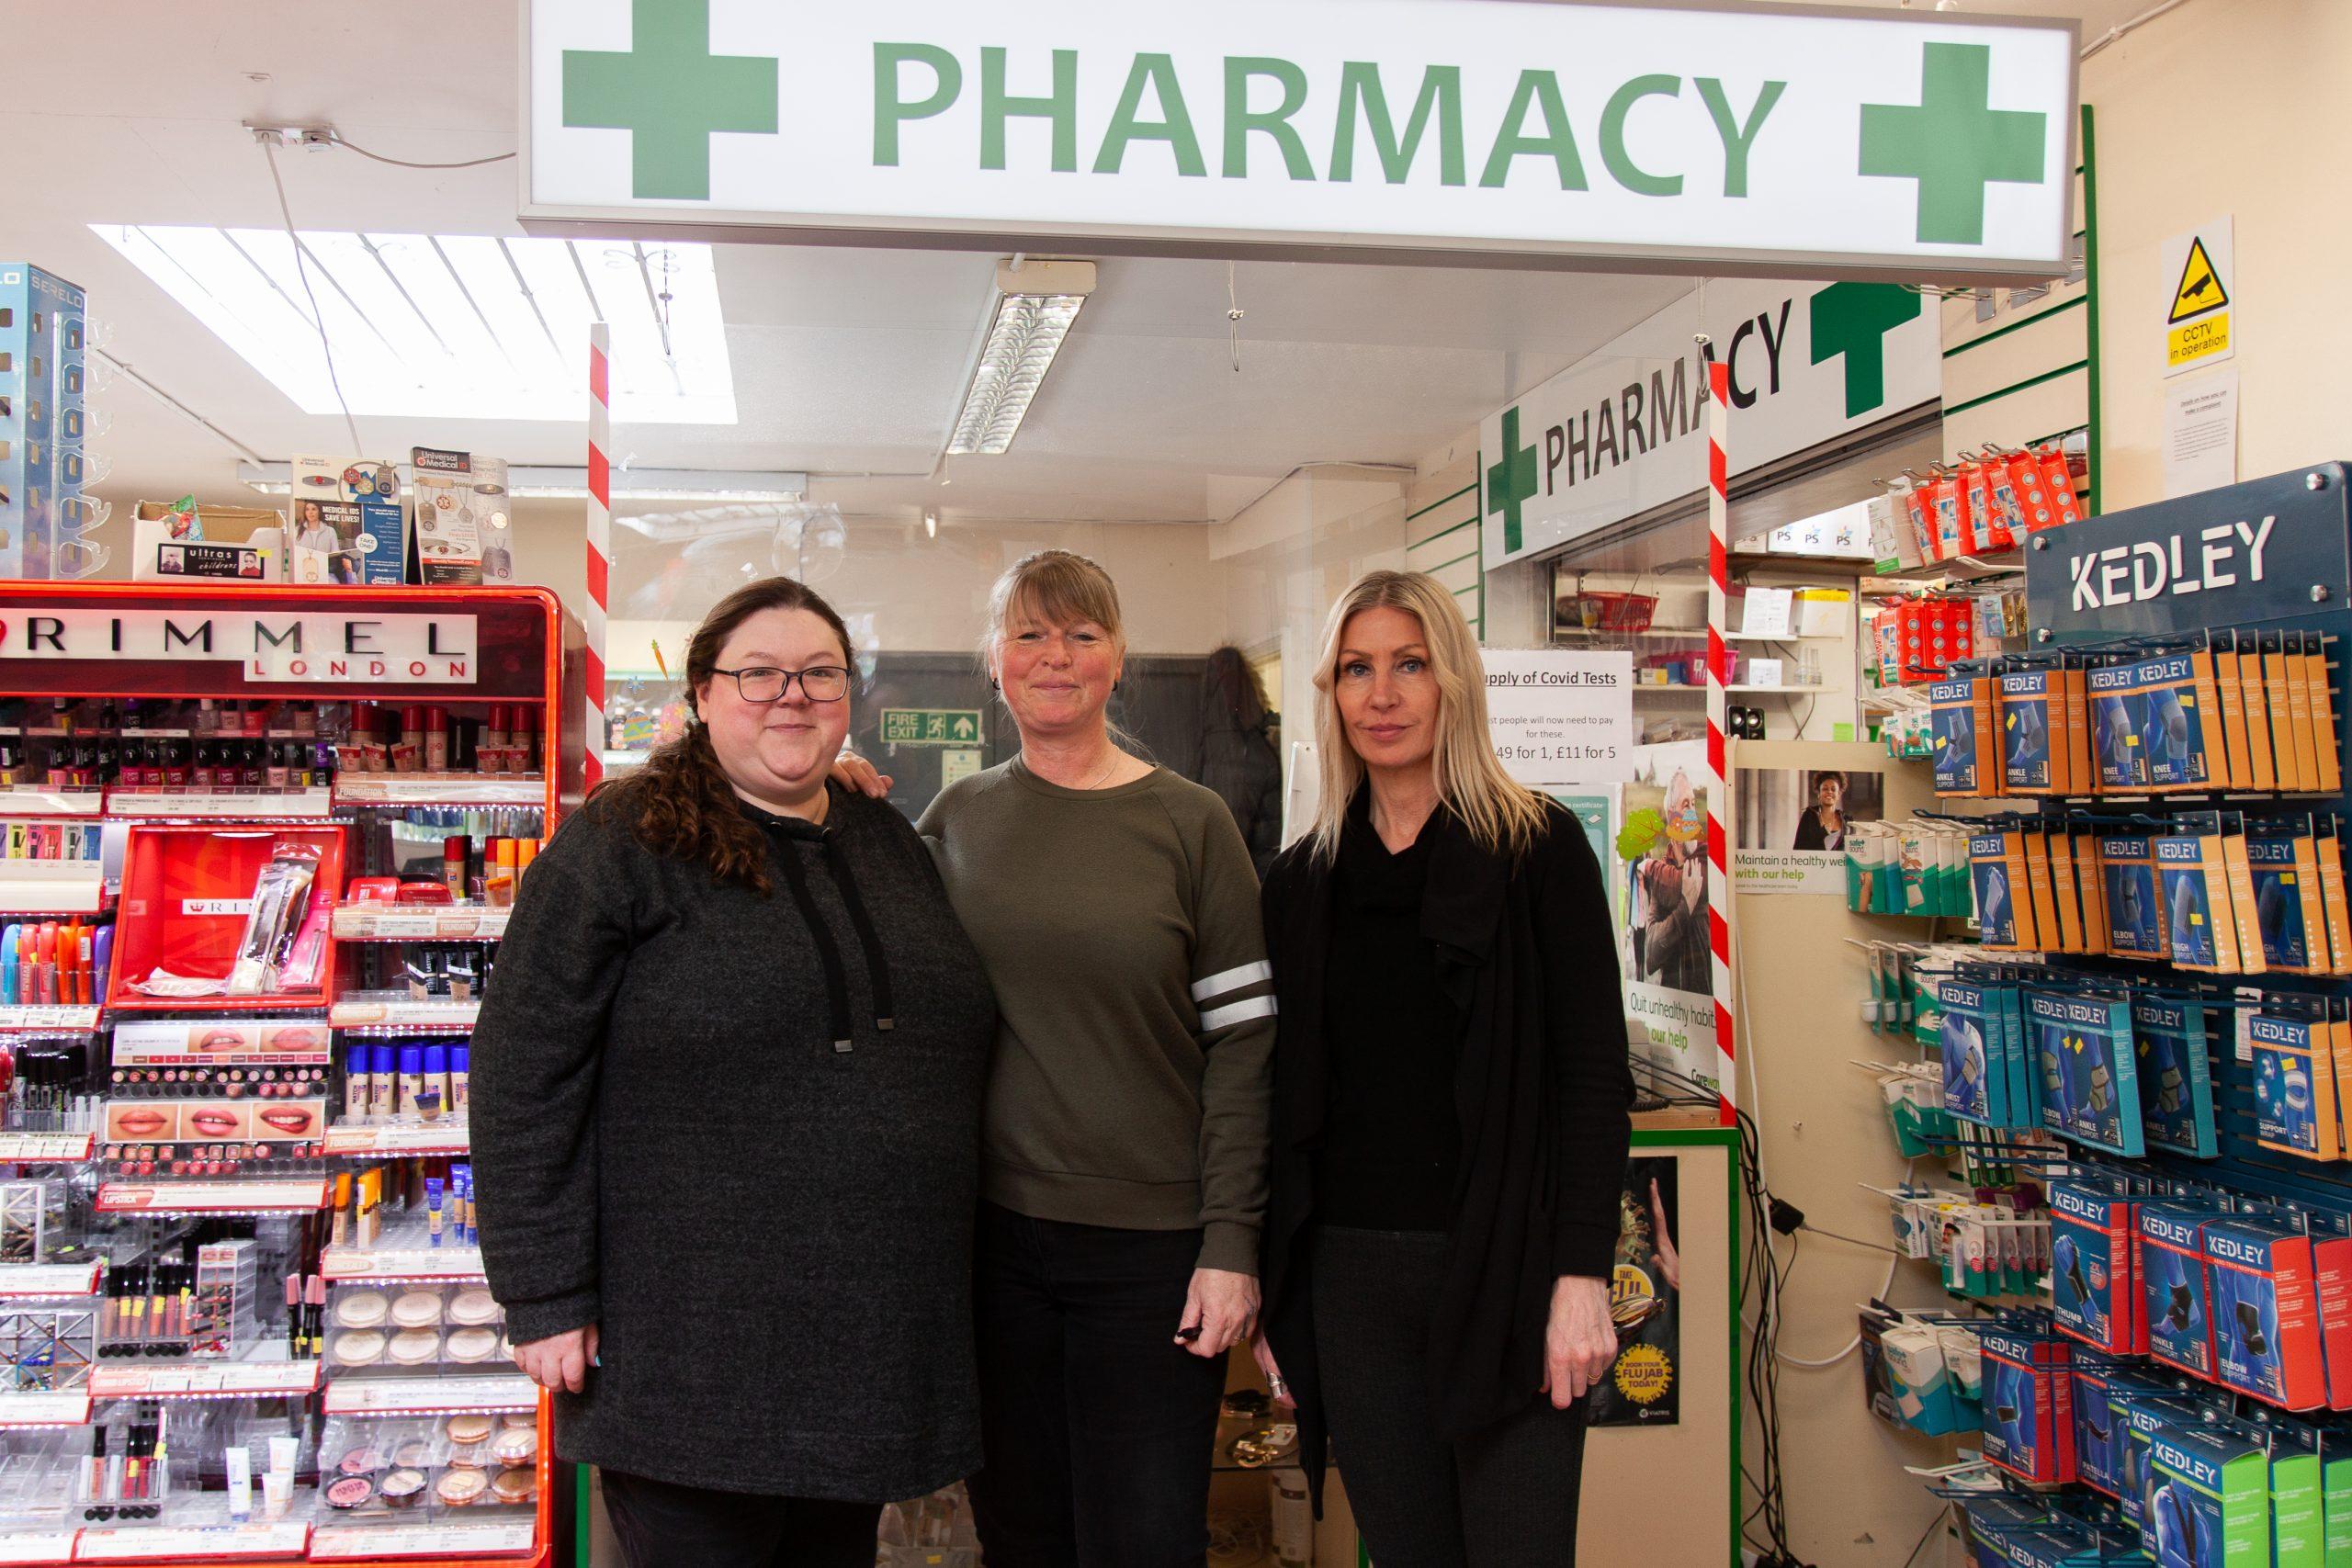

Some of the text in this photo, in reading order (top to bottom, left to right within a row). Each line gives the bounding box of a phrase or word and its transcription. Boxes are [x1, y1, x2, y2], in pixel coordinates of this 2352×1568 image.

[873, 42, 1787, 197] PHARMACY
[31, 276, 83, 309] SERELO
[2183, 321, 2212, 342] CCTV
[2170, 335, 2226, 359] in operation
[1546, 299, 1792, 496] PHARMACY
[422, 450, 458, 461] Universal
[425, 459, 458, 468] Medical
[1777, 531, 1791, 541] PS
[1805, 534, 1819, 544] PS
[1837, 536, 1850, 546] PS
[189, 549, 232, 559] ultras
[2070, 515, 2276, 612] KEDLEY
[27, 616, 466, 656] RIMMEL
[254, 660, 466, 678] LONDON
[2138, 660, 2188, 682] KEDLEY
[1523, 671, 1538, 684] of
[1542, 671, 1578, 684] Covid
[1583, 671, 1617, 684] Tests
[2004, 676, 2042, 692] KEDLEY
[2091, 671, 2132, 688] KEDLEY
[1932, 683, 1969, 700] KEDLEY
[888, 713, 919, 726] FIRE
[1499, 716, 1527, 726] people
[1530, 716, 1544, 725] will
[1566, 716, 1587, 725] need
[1589, 716, 1597, 725] to
[1599, 717, 1613, 727] pay
[888, 726, 919, 738] EXIT
[1526, 729, 1565, 739] for these.
[1517, 746, 1535, 759] for
[1541, 747, 1552, 761] 1,
[1556, 746, 1580, 759] £11
[1586, 746, 1604, 759] for
[1609, 747, 1616, 759] 5
[2007, 768, 2026, 776] ANKLE
[2103, 767, 2118, 775] KNEE
[2153, 764, 2171, 773] KNEE
[2154, 773, 2178, 781] SUPPORT
[339, 787, 382, 796] FOUNDATION
[1971, 839, 2001, 853] KEDLEY
[2105, 841, 2145, 855] KEDLEY
[2158, 843, 2196, 859] KEDLEY
[2247, 844, 2289, 860] EDLEY
[1735, 853, 1780, 865] Maintain
[1781, 856, 1788, 865] a
[1792, 853, 1826, 868] healthy
[1735, 869, 1804, 882] with our help
[2113, 930, 2134, 939] ELBOW
[1941, 987, 1980, 1007] KEDLEY
[1631, 992, 1716, 1029] Quit unhealthy habit
[2032, 998, 2068, 1020] KEDLEY
[2068, 1004, 2107, 1024] KEDLEY
[2136, 1006, 2181, 1027] KEDLEY
[2253, 1021, 2305, 1044] KEDLEY
[1651, 1027, 1688, 1054] our help
[2078, 1121, 2096, 1130] ANKLE
[2259, 1122, 2288, 1134] SUPPORT
[2079, 1129, 2099, 1139] SUPPORT
[2055, 1191, 2105, 1222] KEDLEY
[2142, 1215, 2193, 1245] KEDLEY
[2209, 1235, 2264, 1265] KEDLEY
[1619, 1270, 1633, 1280] TAKE
[2056, 1305, 2082, 1324] THUMB
[1984, 1337, 2028, 1360] KEDLEY
[2153, 1334, 2174, 1349] ANKLE
[2222, 1359, 2247, 1374] ELBOW
[1623, 1369, 1663, 1380] FLU JAB
[2132, 1410, 2162, 1431] KED
[1984, 1431, 2007, 1448] TENNIS
[2155, 1441, 2217, 1485] KEDLEY
